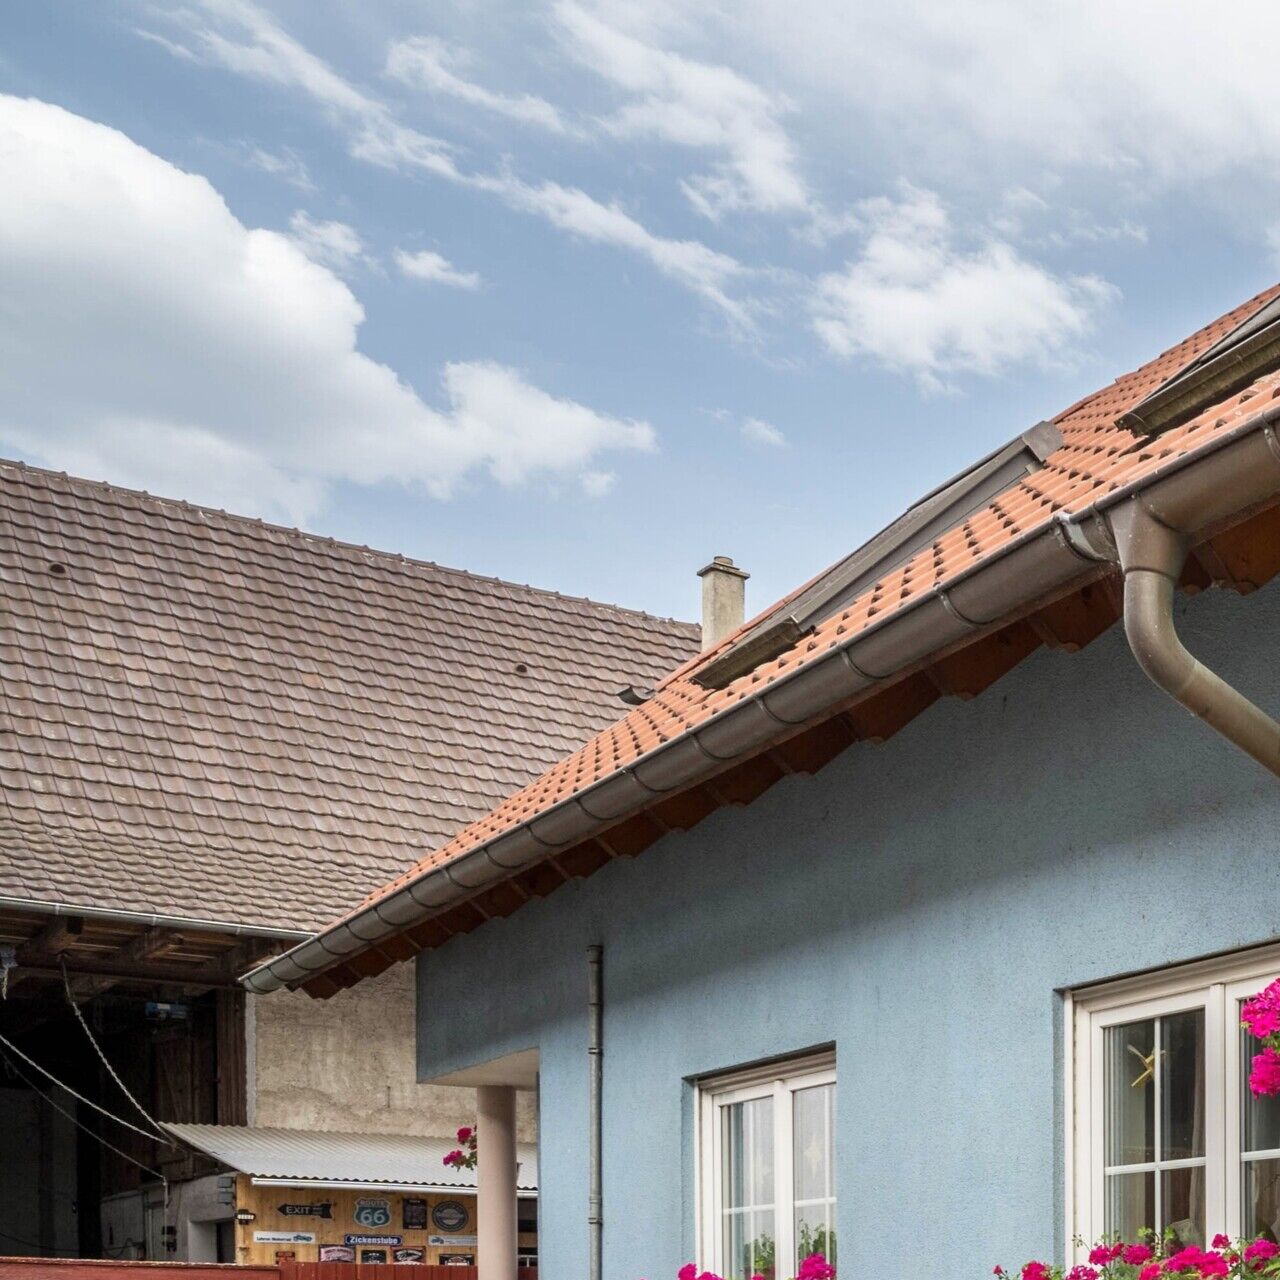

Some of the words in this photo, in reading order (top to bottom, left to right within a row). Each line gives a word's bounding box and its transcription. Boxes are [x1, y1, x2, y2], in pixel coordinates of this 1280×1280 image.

[286, 1206, 310, 1215] EXIT
[360, 1209, 385, 1225] 66
[350, 1236, 399, 1245] Zickenstube
